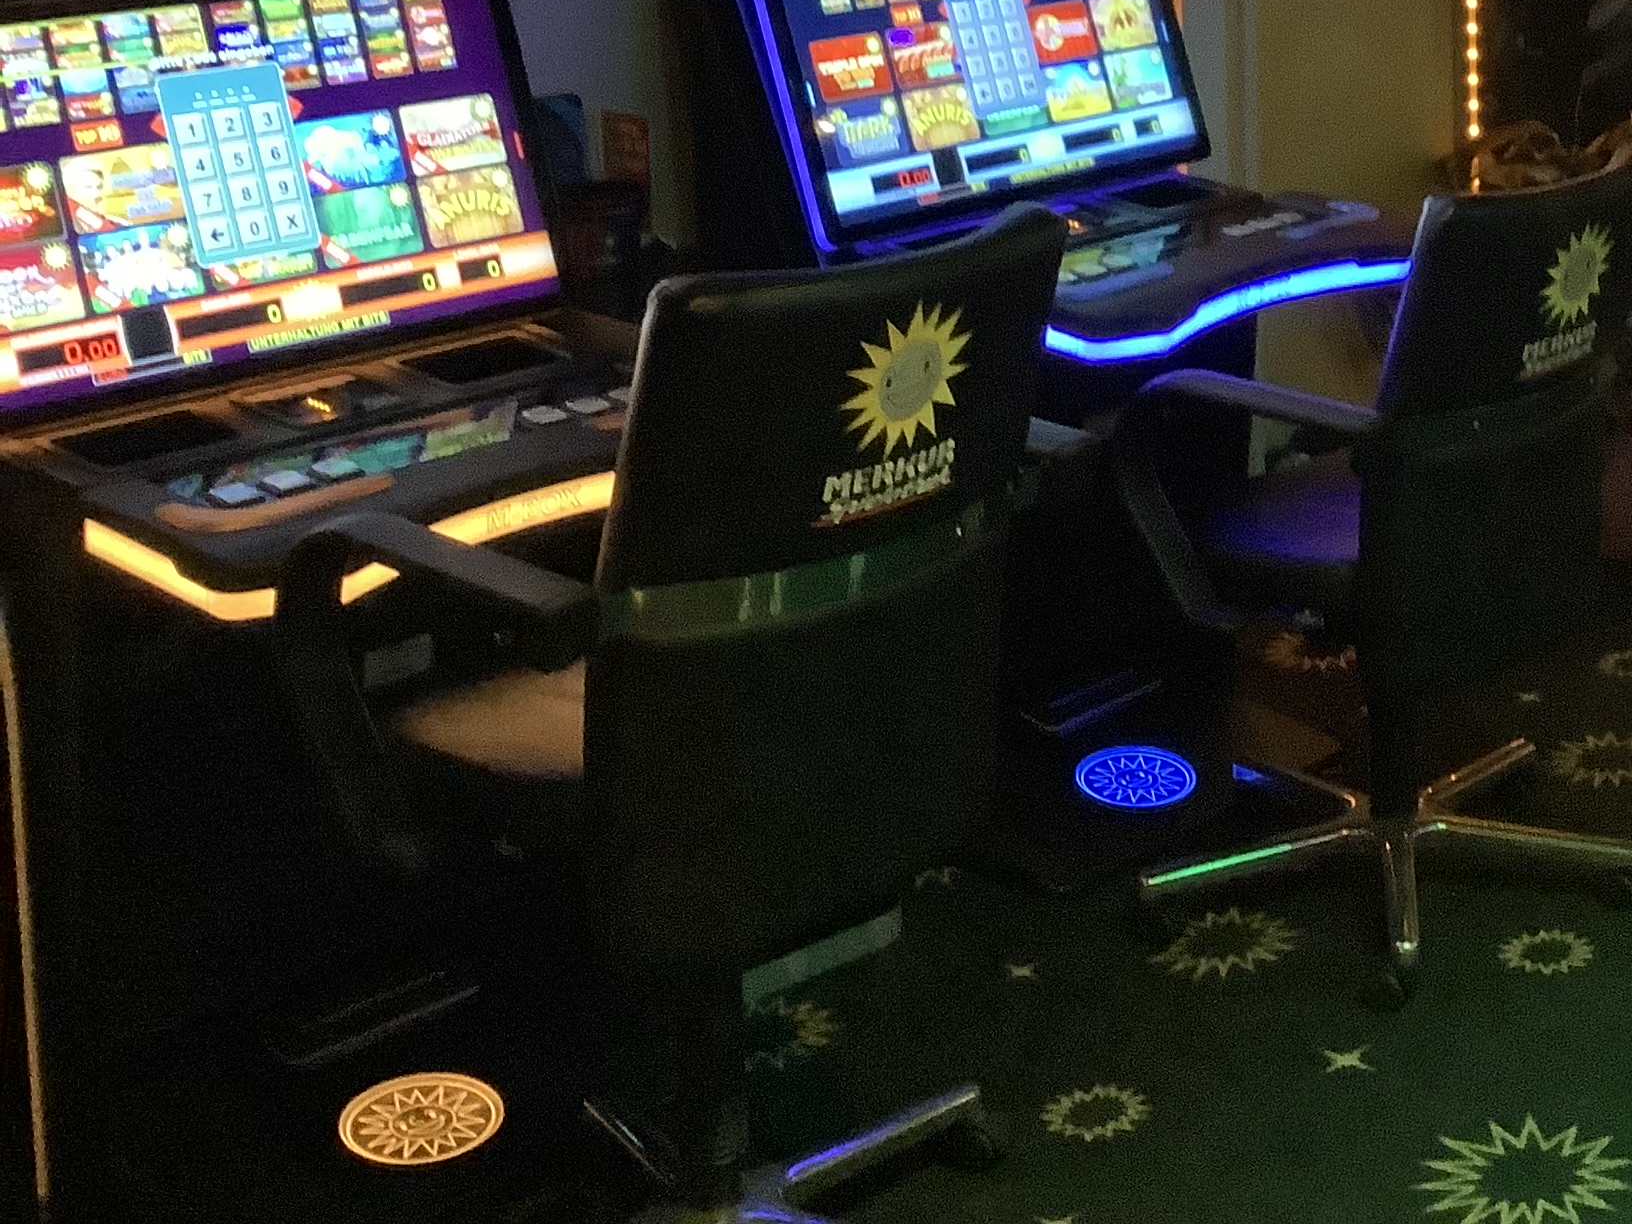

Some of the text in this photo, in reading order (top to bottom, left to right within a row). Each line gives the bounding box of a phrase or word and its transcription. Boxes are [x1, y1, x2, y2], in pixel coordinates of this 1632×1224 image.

[187, 111, 274, 138] 1 2 3
[912, 103, 972, 136] ANURIS
[195, 146, 282, 172] 4 5 6
[202, 180, 289, 208] 7 8 9
[431, 189, 514, 230] ANURIS
[249, 221, 260, 236] 0
[422, 273, 436, 292] 0
[487, 260, 501, 278] 0
[267, 304, 281, 323] 0
[250, 321, 340, 350] UNTERHALTUNG
[63, 338, 118, 365] 0.00
